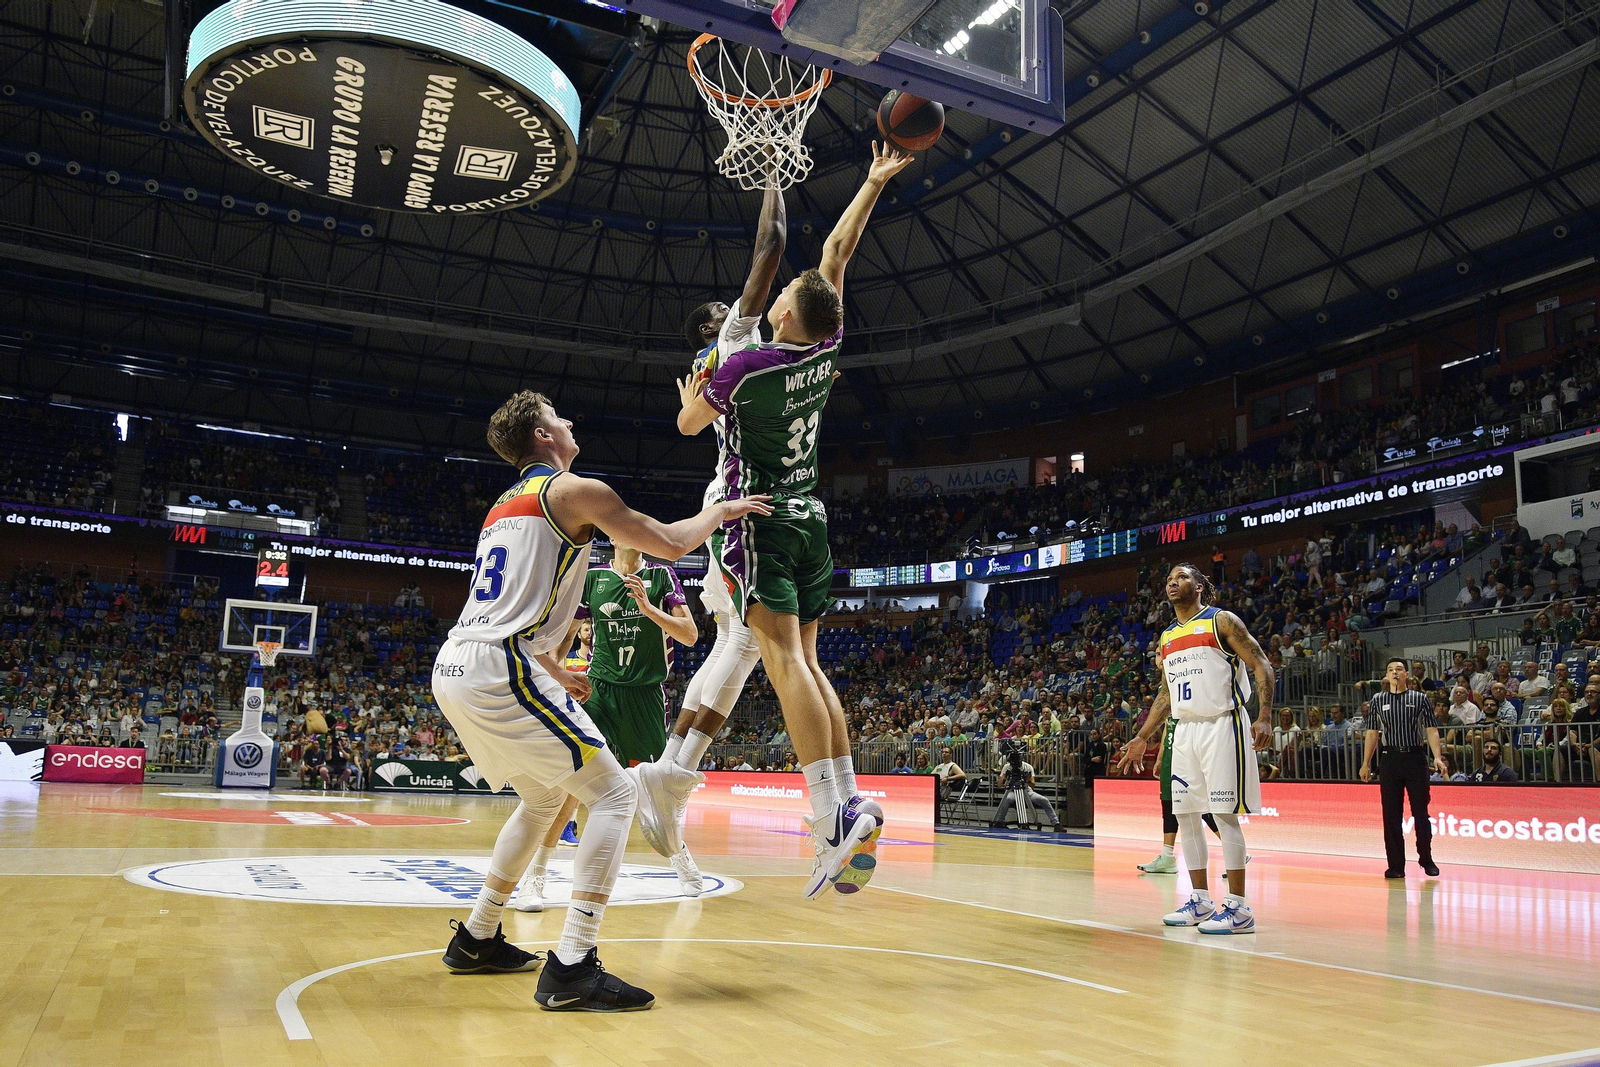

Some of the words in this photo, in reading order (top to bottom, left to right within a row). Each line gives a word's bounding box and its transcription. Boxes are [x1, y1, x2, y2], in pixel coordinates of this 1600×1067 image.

[212, 47, 317, 92] PORTICO
[333, 56, 366, 123] GRUPO
[203, 89, 228, 112] DE
[415, 74, 457, 152] RESERVA
[331, 124, 360, 146] LA
[477, 85, 557, 174] VELAZQUEZ
[205, 112, 314, 189] VELAZQUEZ
[327, 146, 358, 197] RESERVA
[411, 154, 441, 172] LA
[404, 173, 435, 209] GRUPO
[521, 173, 550, 190] DE
[432, 188, 530, 213] PORTICO
[785, 359, 832, 392] WILTJER
[947, 467, 1018, 487] MÁLAGA
[1241, 515, 1259, 529] Tu
[1261, 506, 1301, 526] mejor
[1303, 489, 1384, 518] alternativa
[1387, 485, 1408, 500] de
[1411, 463, 1504, 497] transporte
[6, 514, 26, 524] de
[30, 515, 112, 535] transporte
[265, 550, 287, 560] 9:32
[291, 546, 332, 558] mejor
[334, 549, 405, 565] alternativa
[409, 556, 425, 567] de
[1024, 553, 1032, 567] 0
[259, 561, 288, 578] 2.4
[965, 562, 973, 576] 0
[608, 621, 641, 640] Málaga
[618, 646, 635, 666] 17
[1178, 681, 1191, 701] 16
[51, 751, 142, 769] endesa
[409, 775, 453, 788] Unicaja
[730, 783, 803, 799] visitacostadelsol.com
[1261, 807, 1279, 817] SOL
[1401, 812, 1600, 844] vsitacostade
